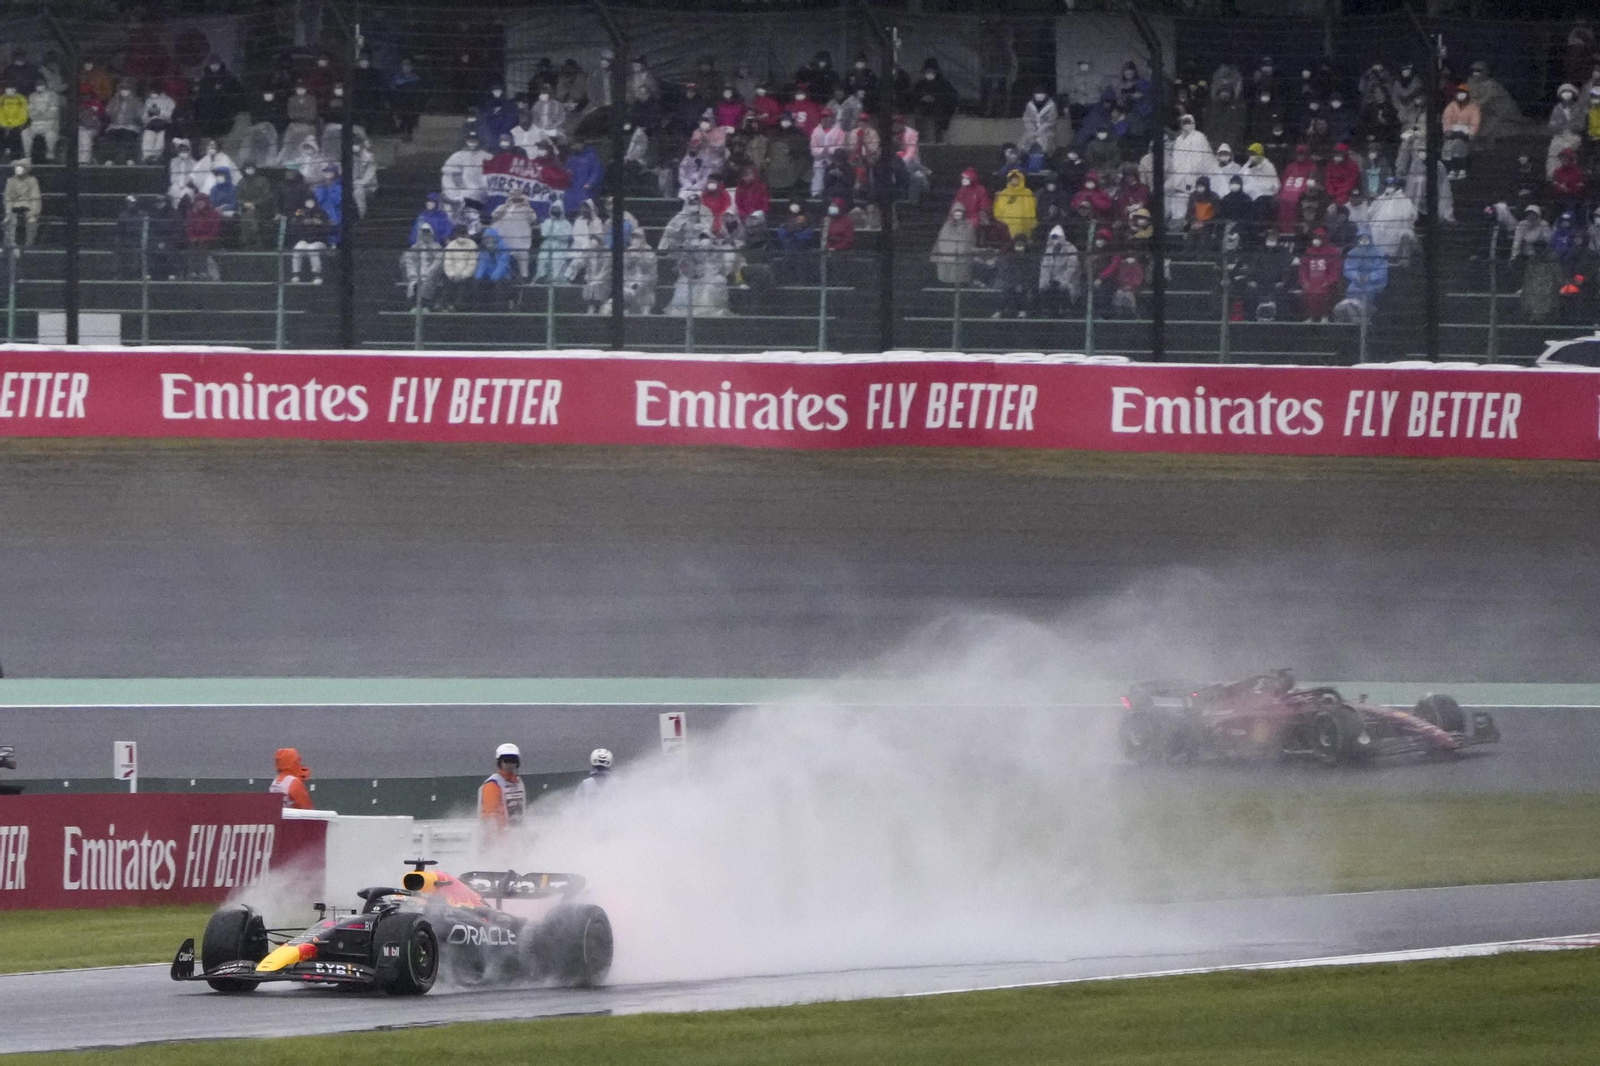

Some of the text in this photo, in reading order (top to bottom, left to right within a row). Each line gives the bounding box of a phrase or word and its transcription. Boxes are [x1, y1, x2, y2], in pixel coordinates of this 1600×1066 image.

[160, 373, 562, 425] Emirates FLY BETTER
[635, 380, 1038, 431] Emirates FLY BETTER
[1111, 386, 1522, 439] Emirates FLY BETTER
[63, 824, 275, 890] Emirates FLY BETTER
[448, 924, 518, 946] ORACLE
